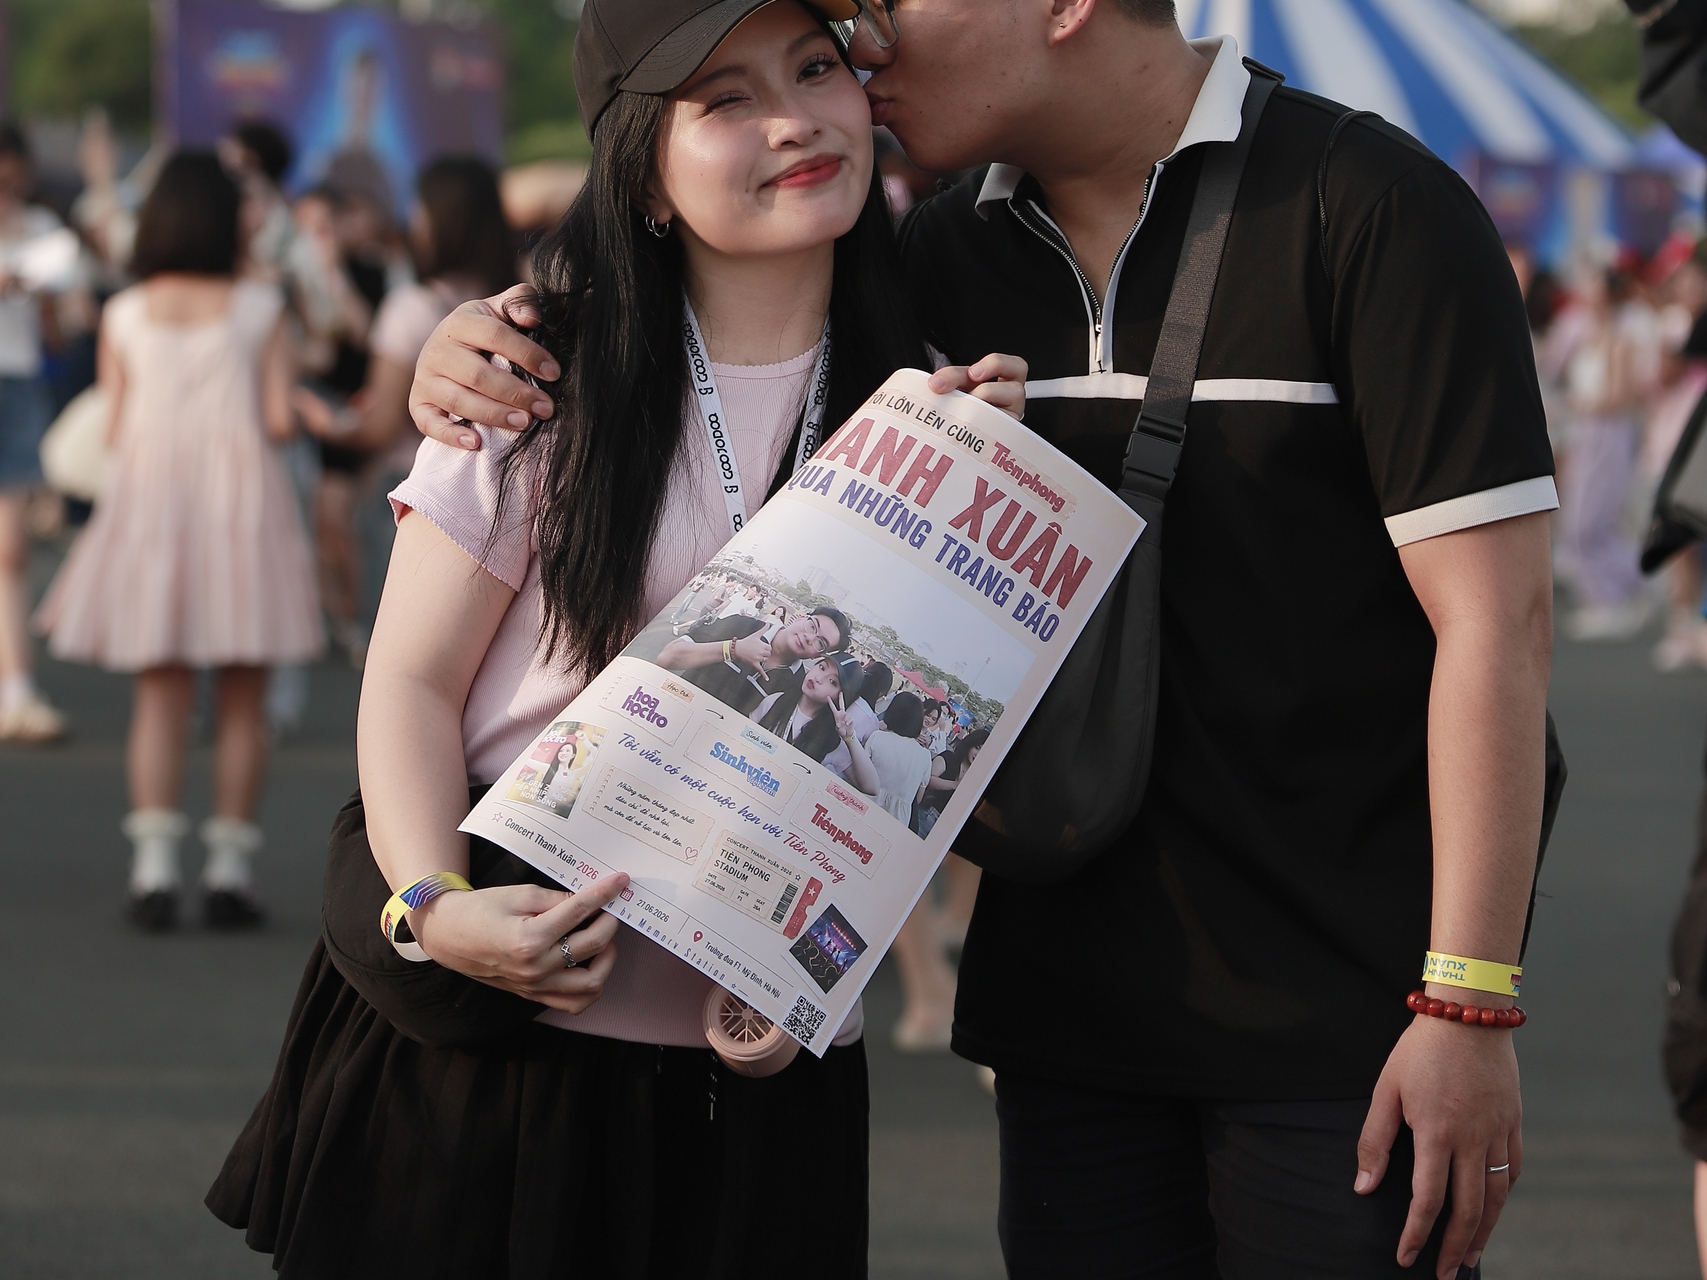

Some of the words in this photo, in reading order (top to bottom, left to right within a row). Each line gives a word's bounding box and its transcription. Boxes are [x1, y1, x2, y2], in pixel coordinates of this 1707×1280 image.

[886, 395, 913, 415] LỚN
[915, 406, 946, 431] LÊN
[947, 423, 985, 454] CÙNG
[709, 412, 734, 480] GOOJODOQ
[948, 476, 1094, 610] XUÂN
[838, 479, 933, 550] NHỮNG
[935, 533, 1015, 608] TRANG
[1012, 592, 1060, 643] BÁO
[618, 733, 640, 751] Tôi
[639, 749, 663, 766] vẫn
[663, 764, 681, 775] có
[680, 774, 708, 792] một
[707, 790, 737, 810] cuộc
[738, 805, 762, 825] hẹn
[762, 822, 784, 838] với
[783, 831, 809, 856] Tiền
[809, 850, 846, 884] Phong
[504, 817, 535, 840] Concert
[534, 833, 558, 855] Thanh
[556, 847, 577, 867] Xuân
[576, 861, 599, 881] 2026
[726, 836, 749, 851] CONCERT
[714, 859, 749, 883] STADIUM
[719, 848, 741, 865] TIỀN
[742, 861, 771, 883] PHONG
[636, 899, 670, 923] 27.06.2026
[684, 947, 726, 982] Station
[1428, 970, 1466, 982] THANH
[1430, 957, 1467, 971] XUÂN
[763, 981, 772, 992] Hà
